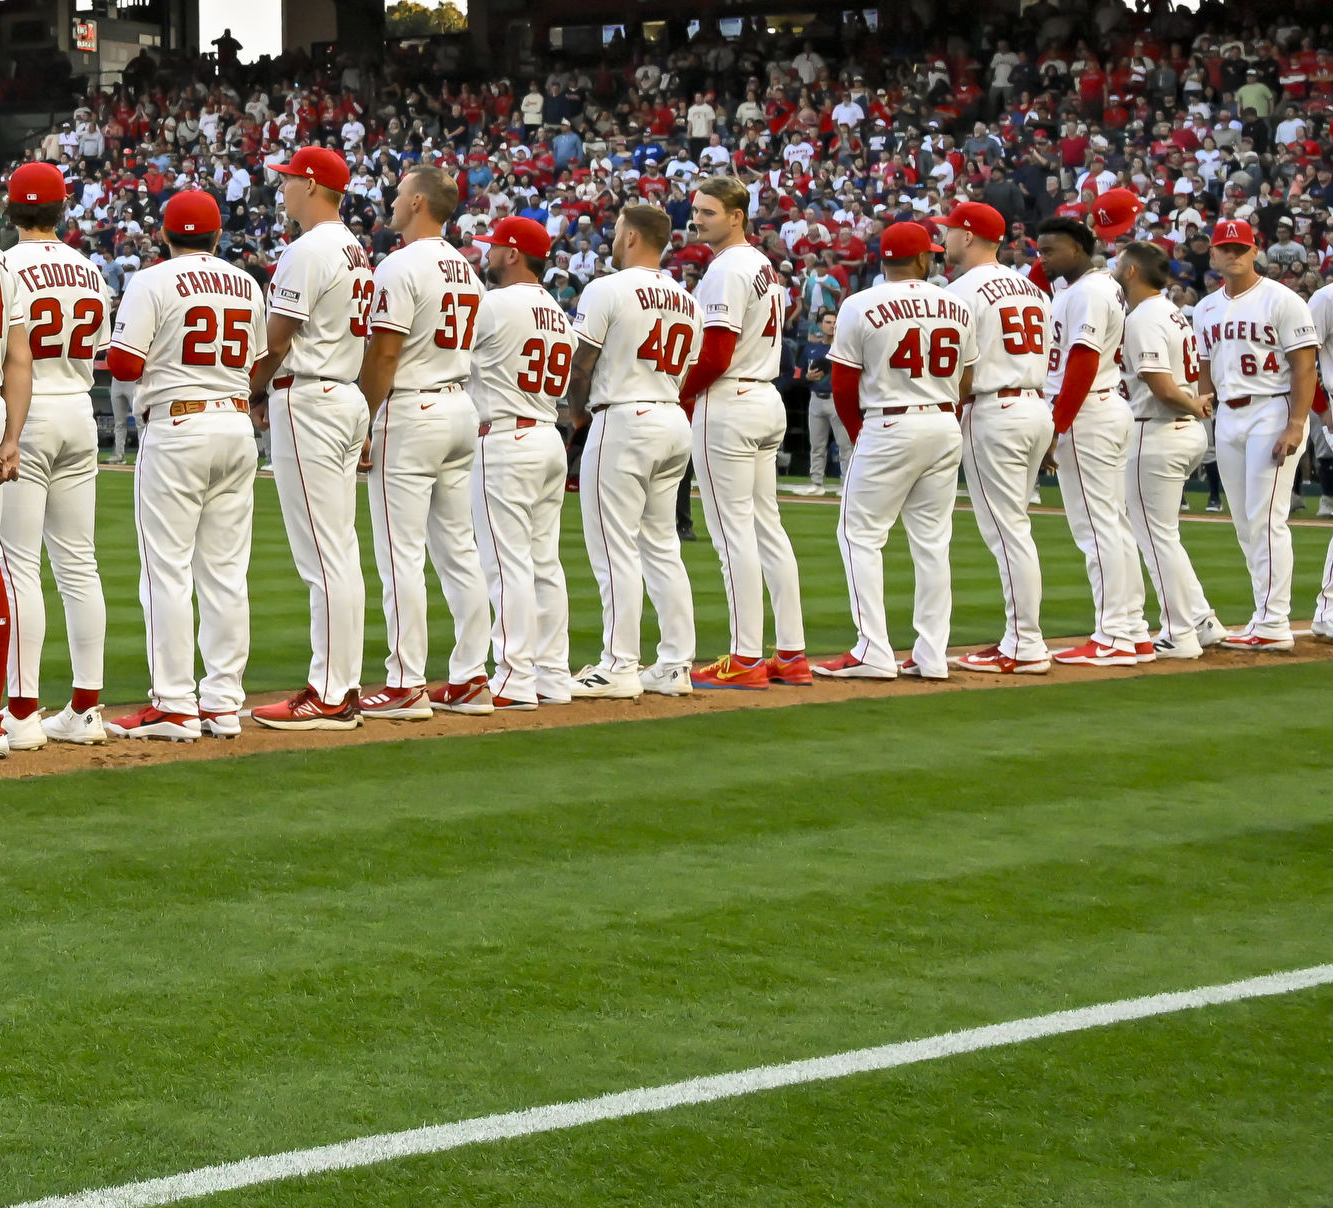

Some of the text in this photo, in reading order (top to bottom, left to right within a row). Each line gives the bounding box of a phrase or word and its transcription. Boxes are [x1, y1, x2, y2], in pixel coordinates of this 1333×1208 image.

[17, 263, 100, 293] TEODOSIO
[175, 270, 252, 302] d'ARNAUD
[438, 260, 471, 285] SUTER
[635, 287, 695, 320] BACHMAN
[865, 298, 970, 329] CANDELARIO
[29, 297, 104, 360] 22
[181, 305, 252, 368] 25
[434, 292, 479, 350] 37
[532, 307, 566, 334] YATES
[999, 306, 1045, 355] 56
[1204, 321, 1276, 353] ANGELS
[637, 318, 693, 376] 40
[889, 327, 961, 379] 46
[517, 337, 572, 397] 39
[1241, 353, 1280, 376] 64
